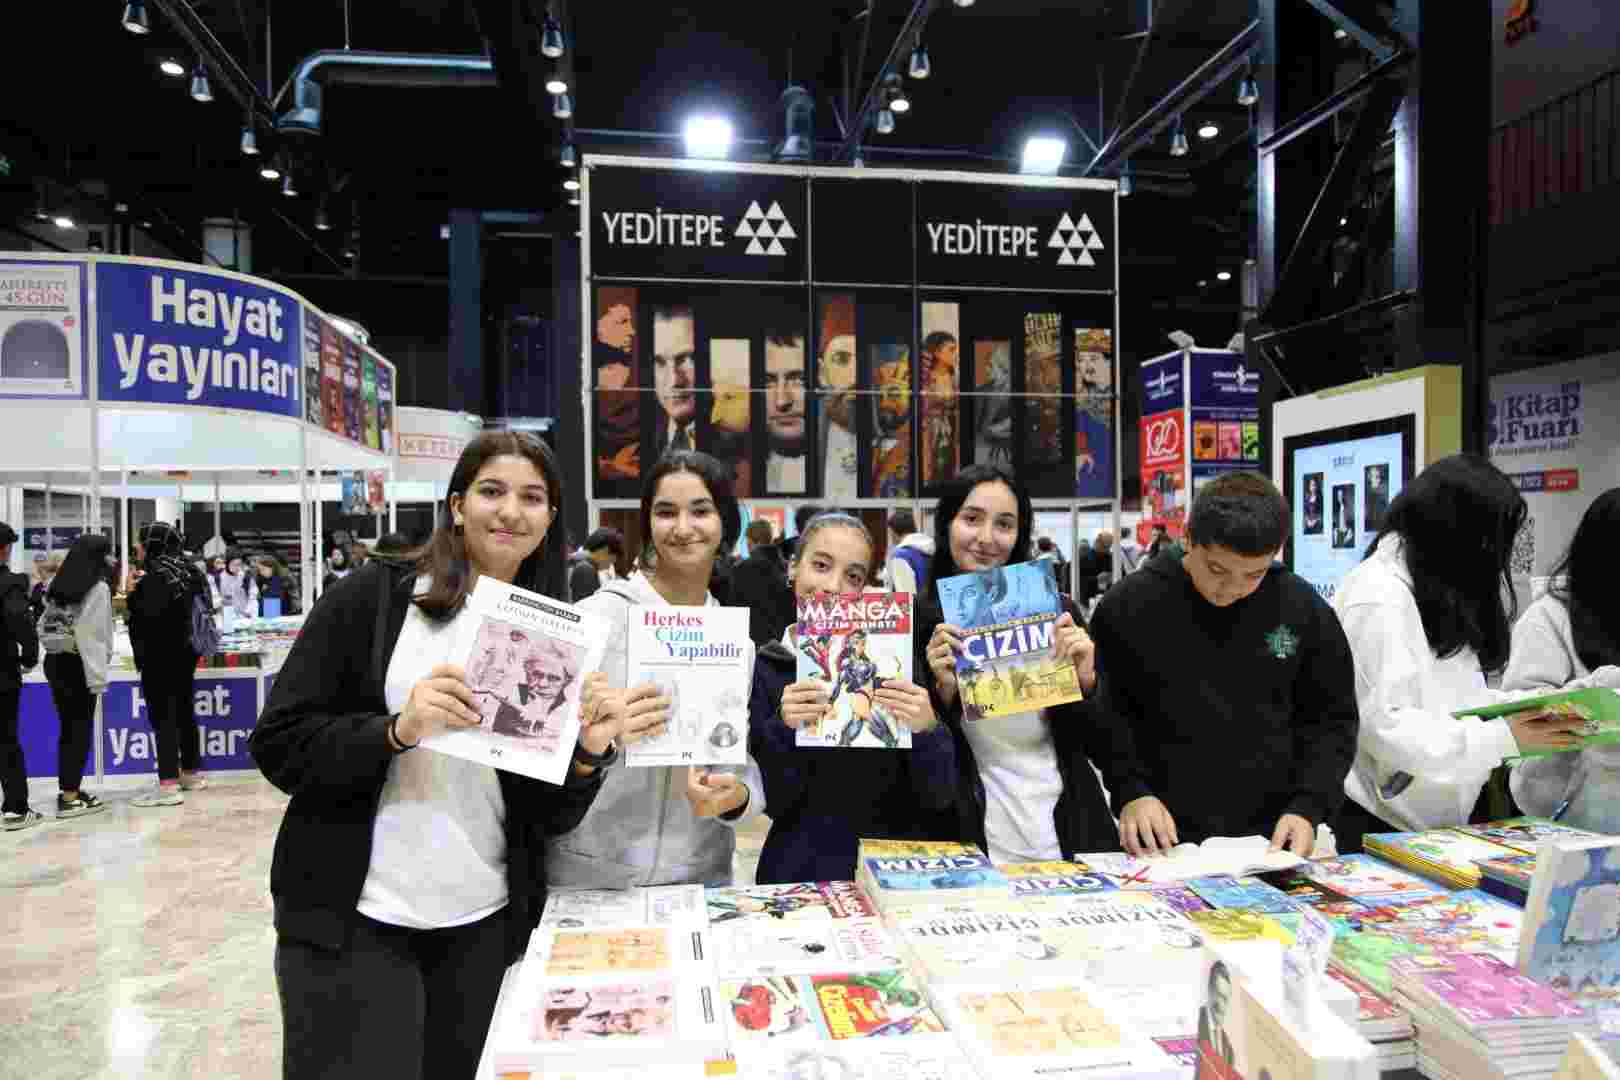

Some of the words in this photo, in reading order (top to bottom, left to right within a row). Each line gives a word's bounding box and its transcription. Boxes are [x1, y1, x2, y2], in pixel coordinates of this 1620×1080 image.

[601, 206, 724, 247] YEDİTEPE
[927, 217, 1039, 257] YEDİTEPE
[151, 274, 284, 346] Hayat
[111, 332, 298, 400] yayınları
[1507, 392, 1579, 419] Kitap
[1507, 417, 1579, 443] Fuarı
[643, 610, 704, 626] Herkes
[803, 600, 904, 621] MANGA
[664, 641, 743, 662] Yapabilir
[132, 685, 230, 719] Hat
[108, 726, 254, 767] yalar
